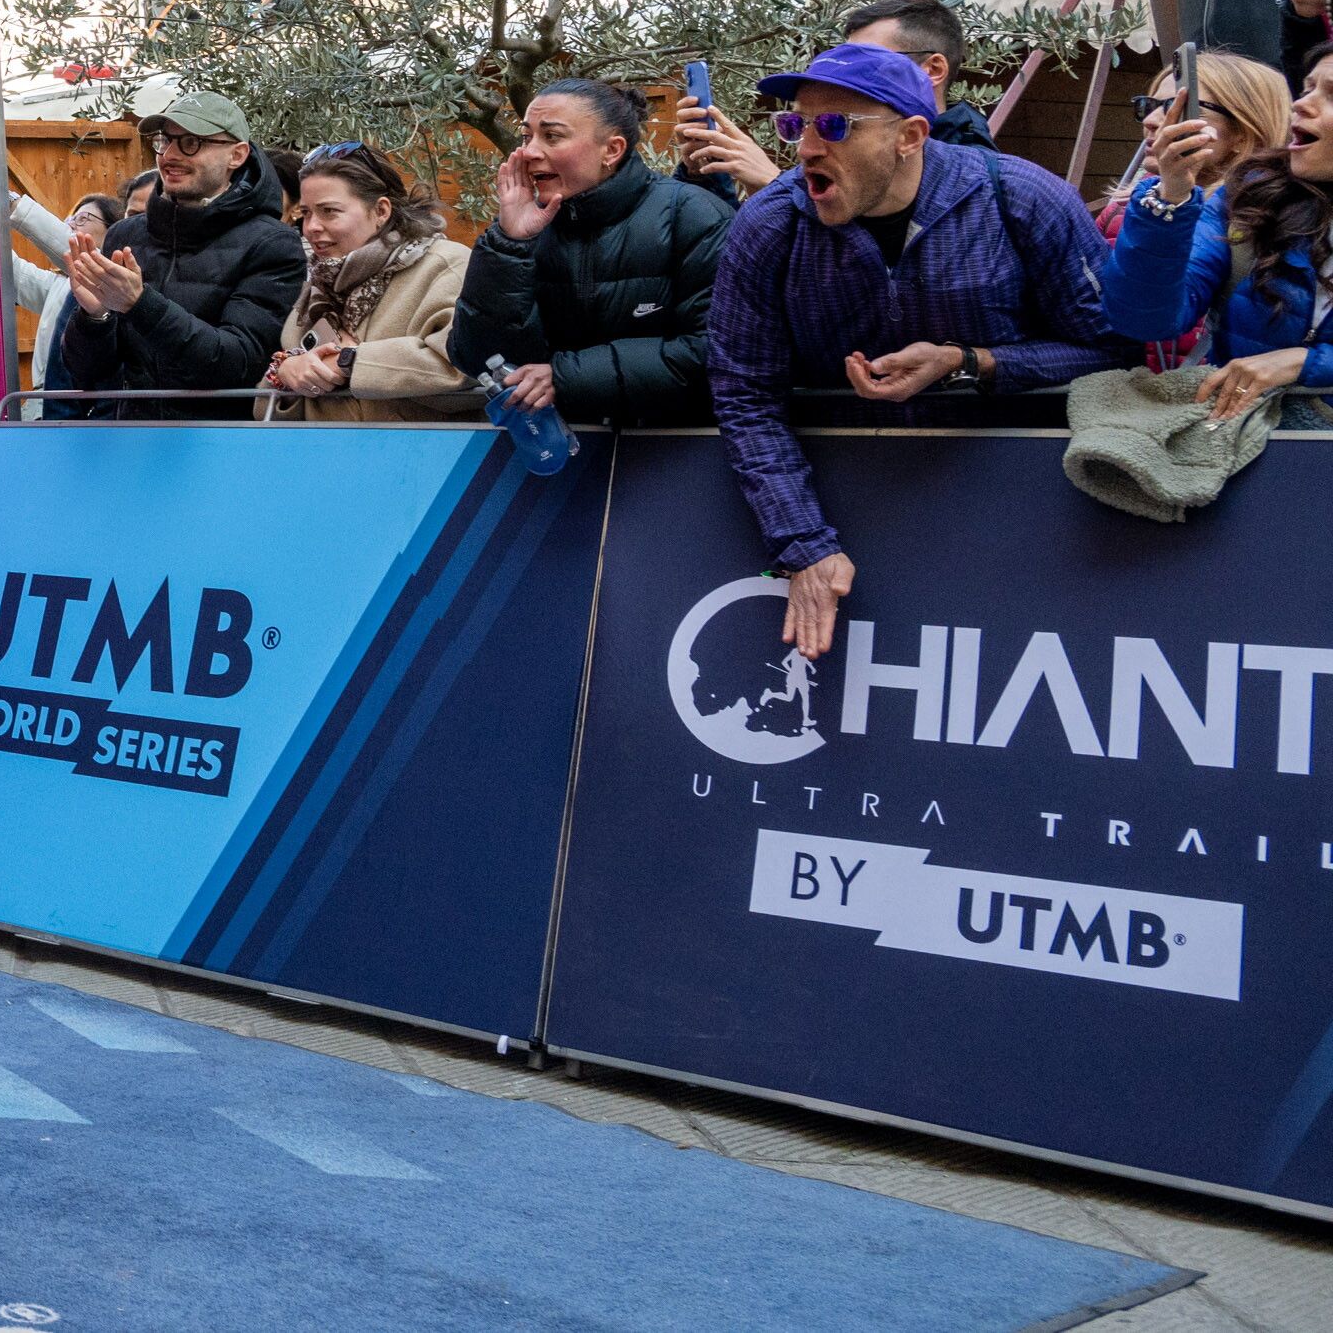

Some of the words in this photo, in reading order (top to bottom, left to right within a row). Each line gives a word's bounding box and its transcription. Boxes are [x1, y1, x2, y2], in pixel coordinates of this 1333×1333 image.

[93, 726, 223, 780] SERIES
[693, 773, 946, 826] ULTRA
[790, 852, 867, 906] BY
[957, 887, 1171, 969] UTMB
